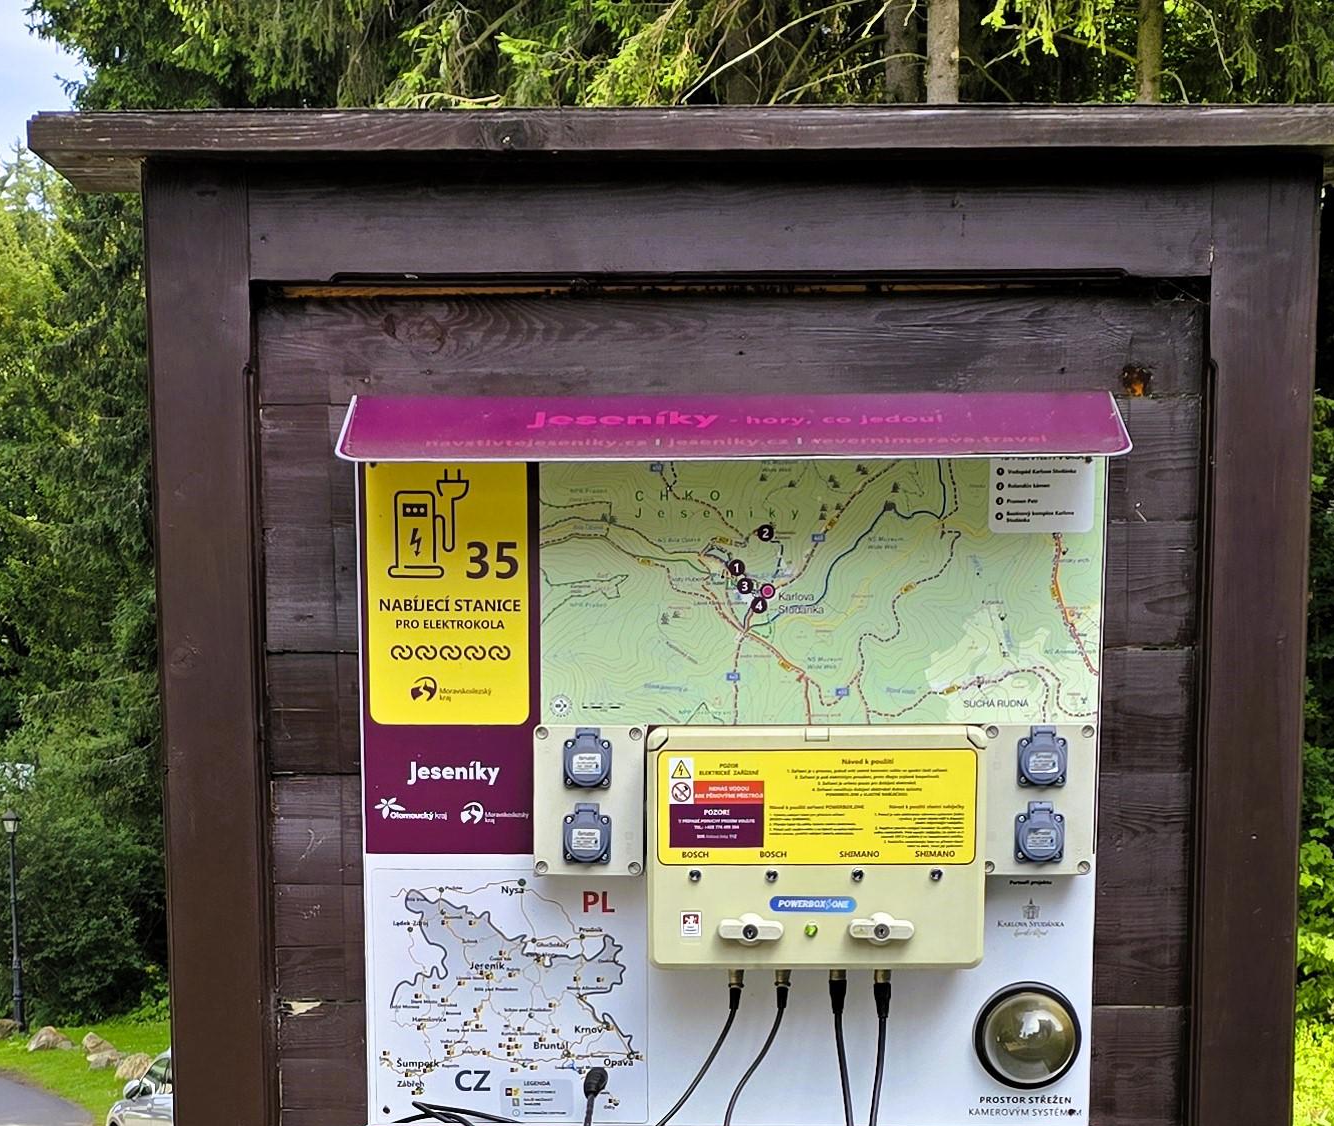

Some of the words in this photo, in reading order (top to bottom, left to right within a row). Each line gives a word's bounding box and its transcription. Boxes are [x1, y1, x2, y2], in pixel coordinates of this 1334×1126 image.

[527, 409, 719, 429] Jeseníky
[746, 414, 812, 427] hory,
[822, 416, 852, 425] co
[860, 413, 944, 426] jedou!
[465, 541, 519, 580] 35
[778, 592, 815, 602] Karlova
[379, 595, 450, 612] NABÍJECÍ
[454, 598, 521, 612] STANICE
[395, 619, 419, 629] PRO
[423, 619, 505, 629] ELEKTROKOLA
[871, 758, 894, 766] použití
[407, 761, 500, 785] Jeseníky
[390, 810, 434, 821] Olomoucký
[434, 811, 448, 821] kraj
[915, 850, 955, 858] SHIMANO
[501, 886, 524, 897] Nysa
[583, 891, 616, 913] PL
[778, 899, 825, 908] POWERBOX
[833, 900, 850, 909] ONE
[574, 1025, 603, 1034] Krnov
[533, 1041, 567, 1050] Bruntál
[604, 1059, 634, 1068] Opava
[455, 1070, 491, 1092] CZ
[979, 1096, 1026, 1104] PROSTOR
[1029, 1094, 1072, 1104] STŘEŽEN
[969, 1107, 1029, 1116] KAMEROVÝM
[1032, 1107, 1082, 1116] SYSTÉMM
